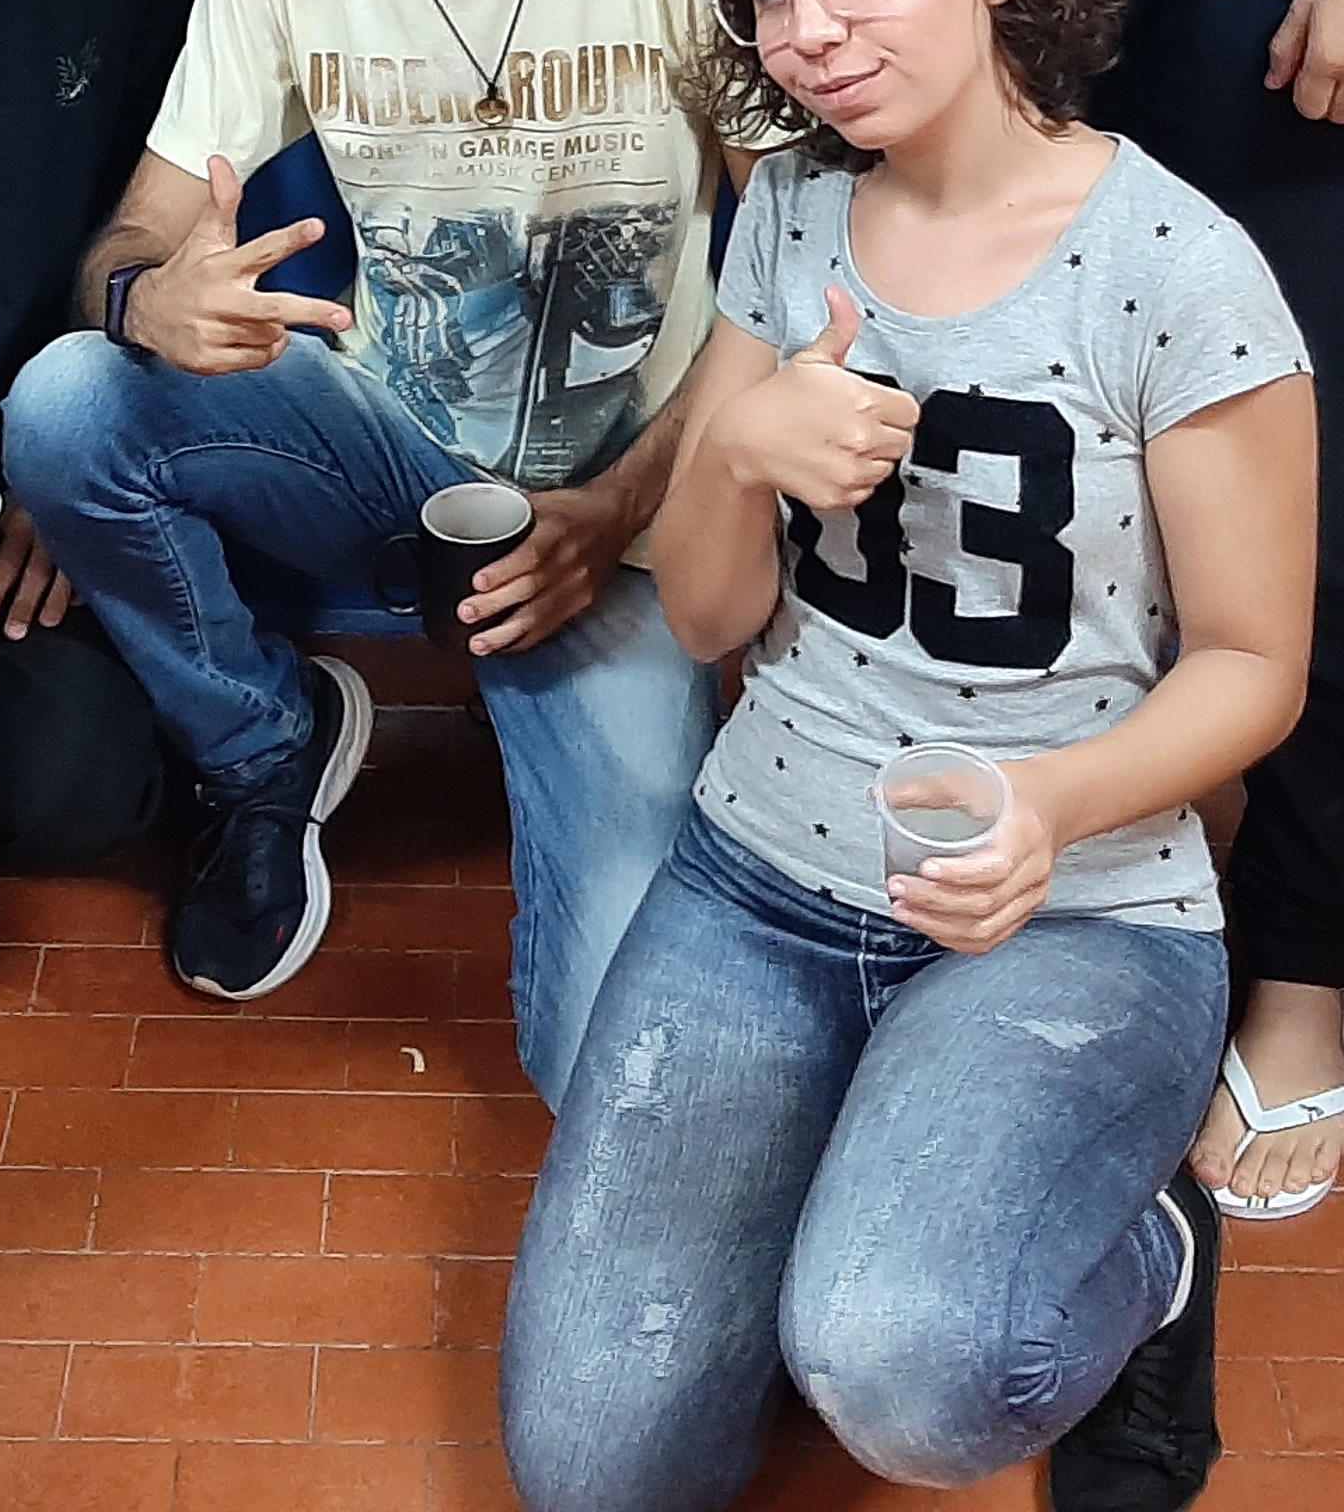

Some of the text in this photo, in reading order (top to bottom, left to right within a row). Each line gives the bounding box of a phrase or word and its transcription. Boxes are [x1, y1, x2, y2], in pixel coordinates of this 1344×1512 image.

[459, 138, 555, 161] GARAGE
[564, 132, 645, 157] MUSIC
[531, 157, 622, 184] CENTRE
